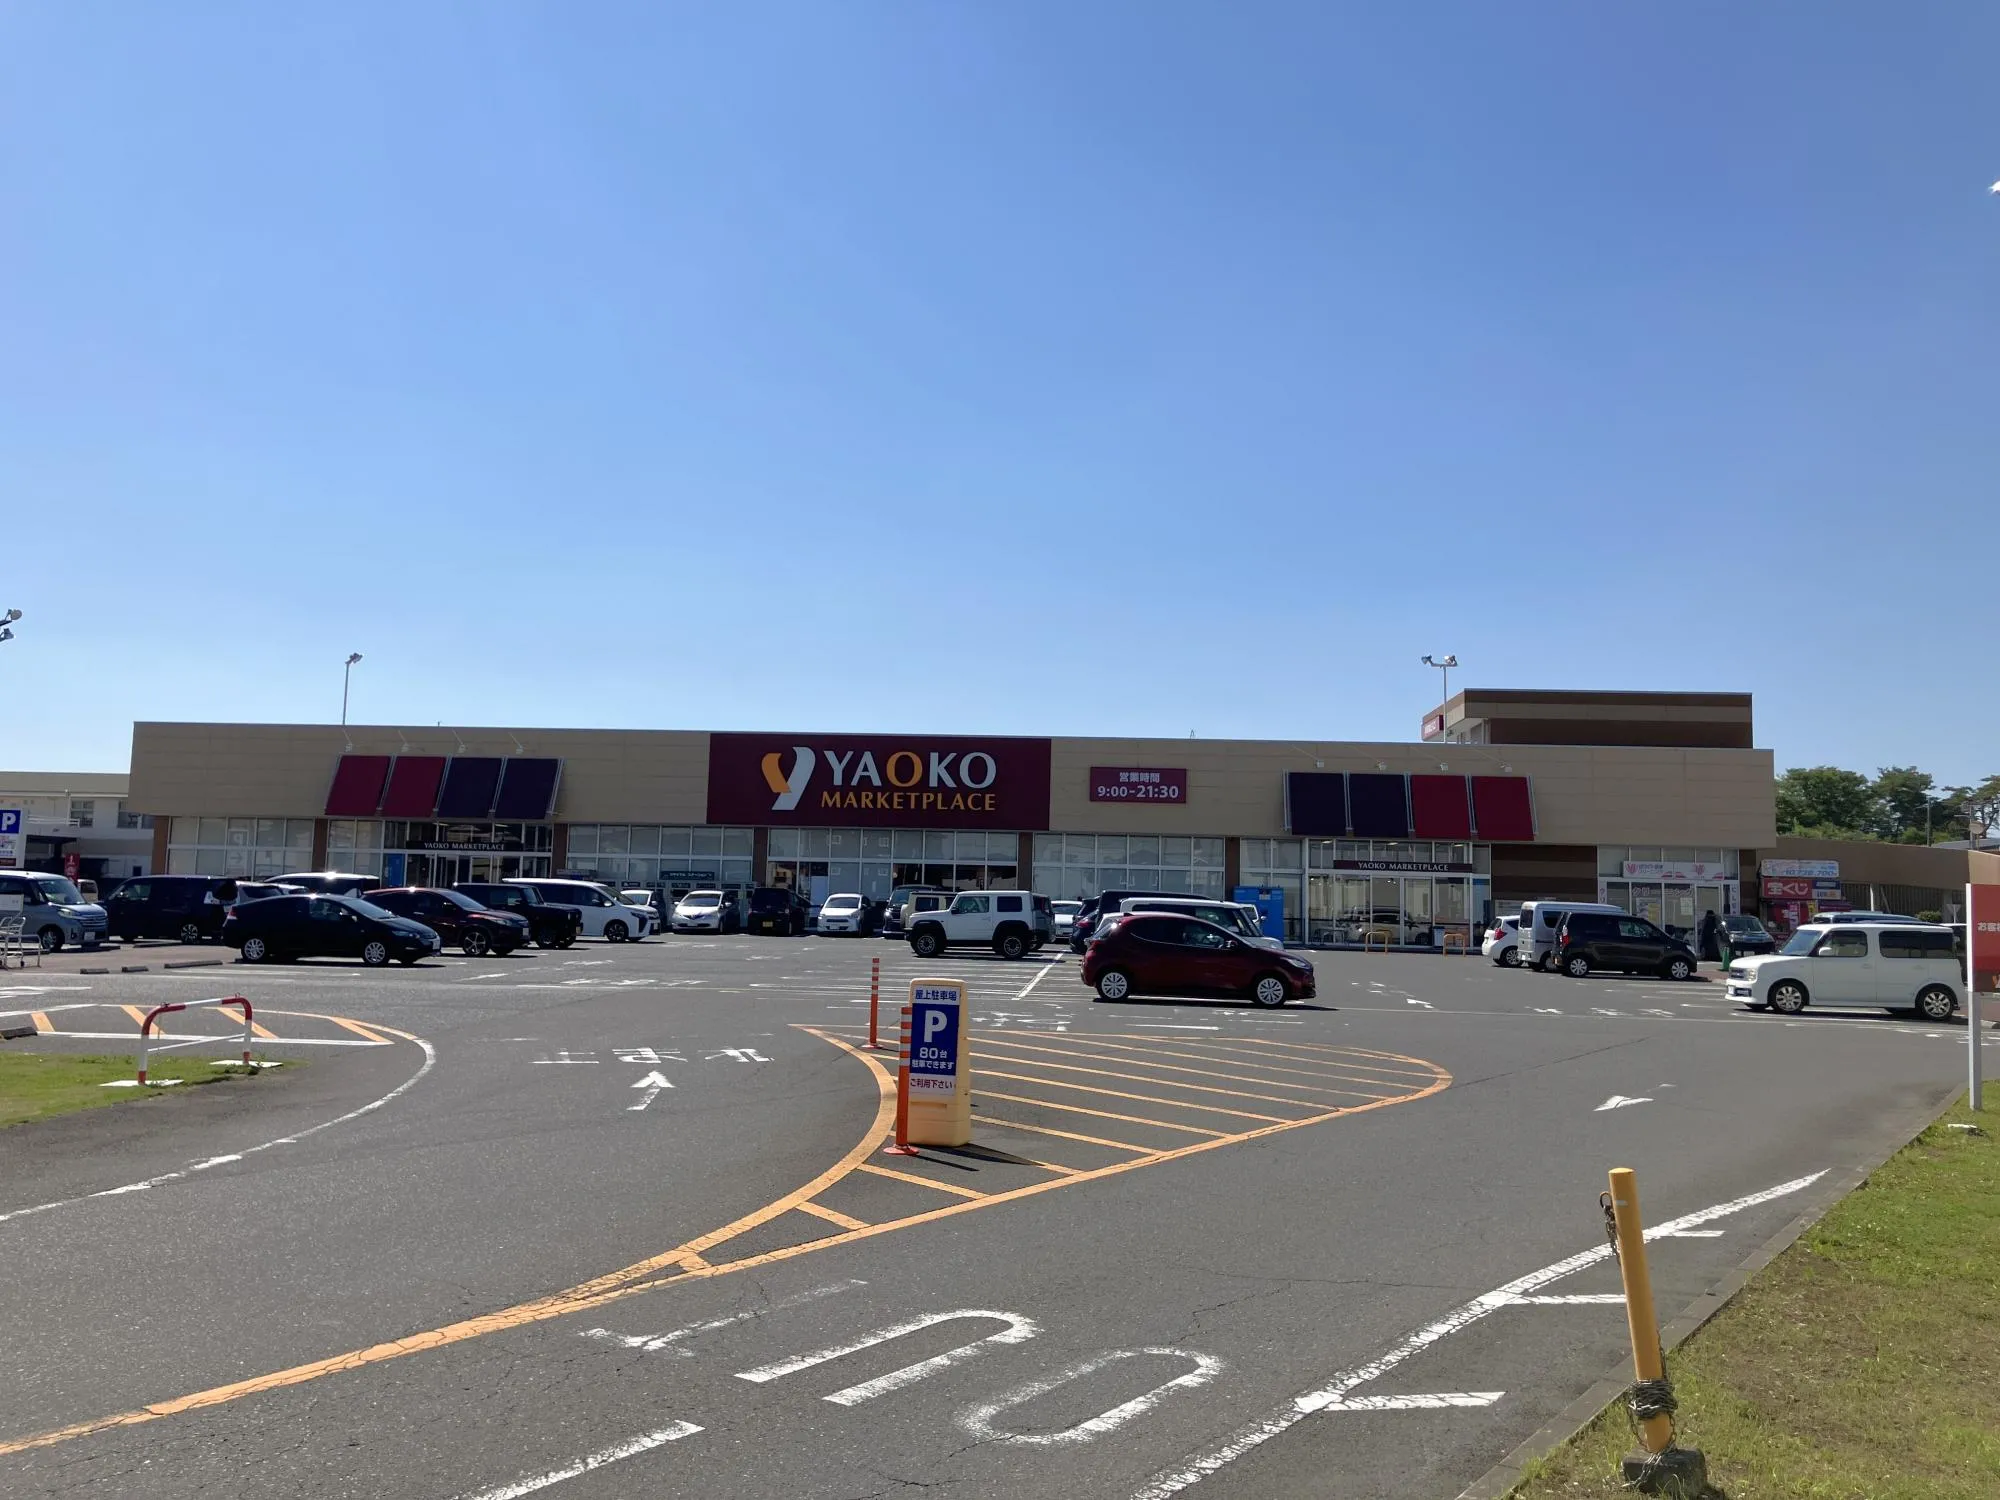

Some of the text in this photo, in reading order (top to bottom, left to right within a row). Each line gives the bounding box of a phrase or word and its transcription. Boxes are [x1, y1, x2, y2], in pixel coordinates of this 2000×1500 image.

[823, 750, 997, 789] YAOKO
[1119, 771, 1161, 783] 営業時間
[820, 791, 996, 811] MARKETPLACE
[424, 842, 505, 851] YAOKO MARKETPLACE
[1357, 861, 1449, 872] YAOKO MARKETPLACE
[1767, 881, 1809, 896] 宝くじ
[915, 989, 957, 1001] 屋上駐車場
[924, 1009, 948, 1043] P
[919, 1047, 948, 1059] 80台
[911, 1059, 955, 1070] 駐車できます
[910, 1078, 953, 1089] ご利用下さい
